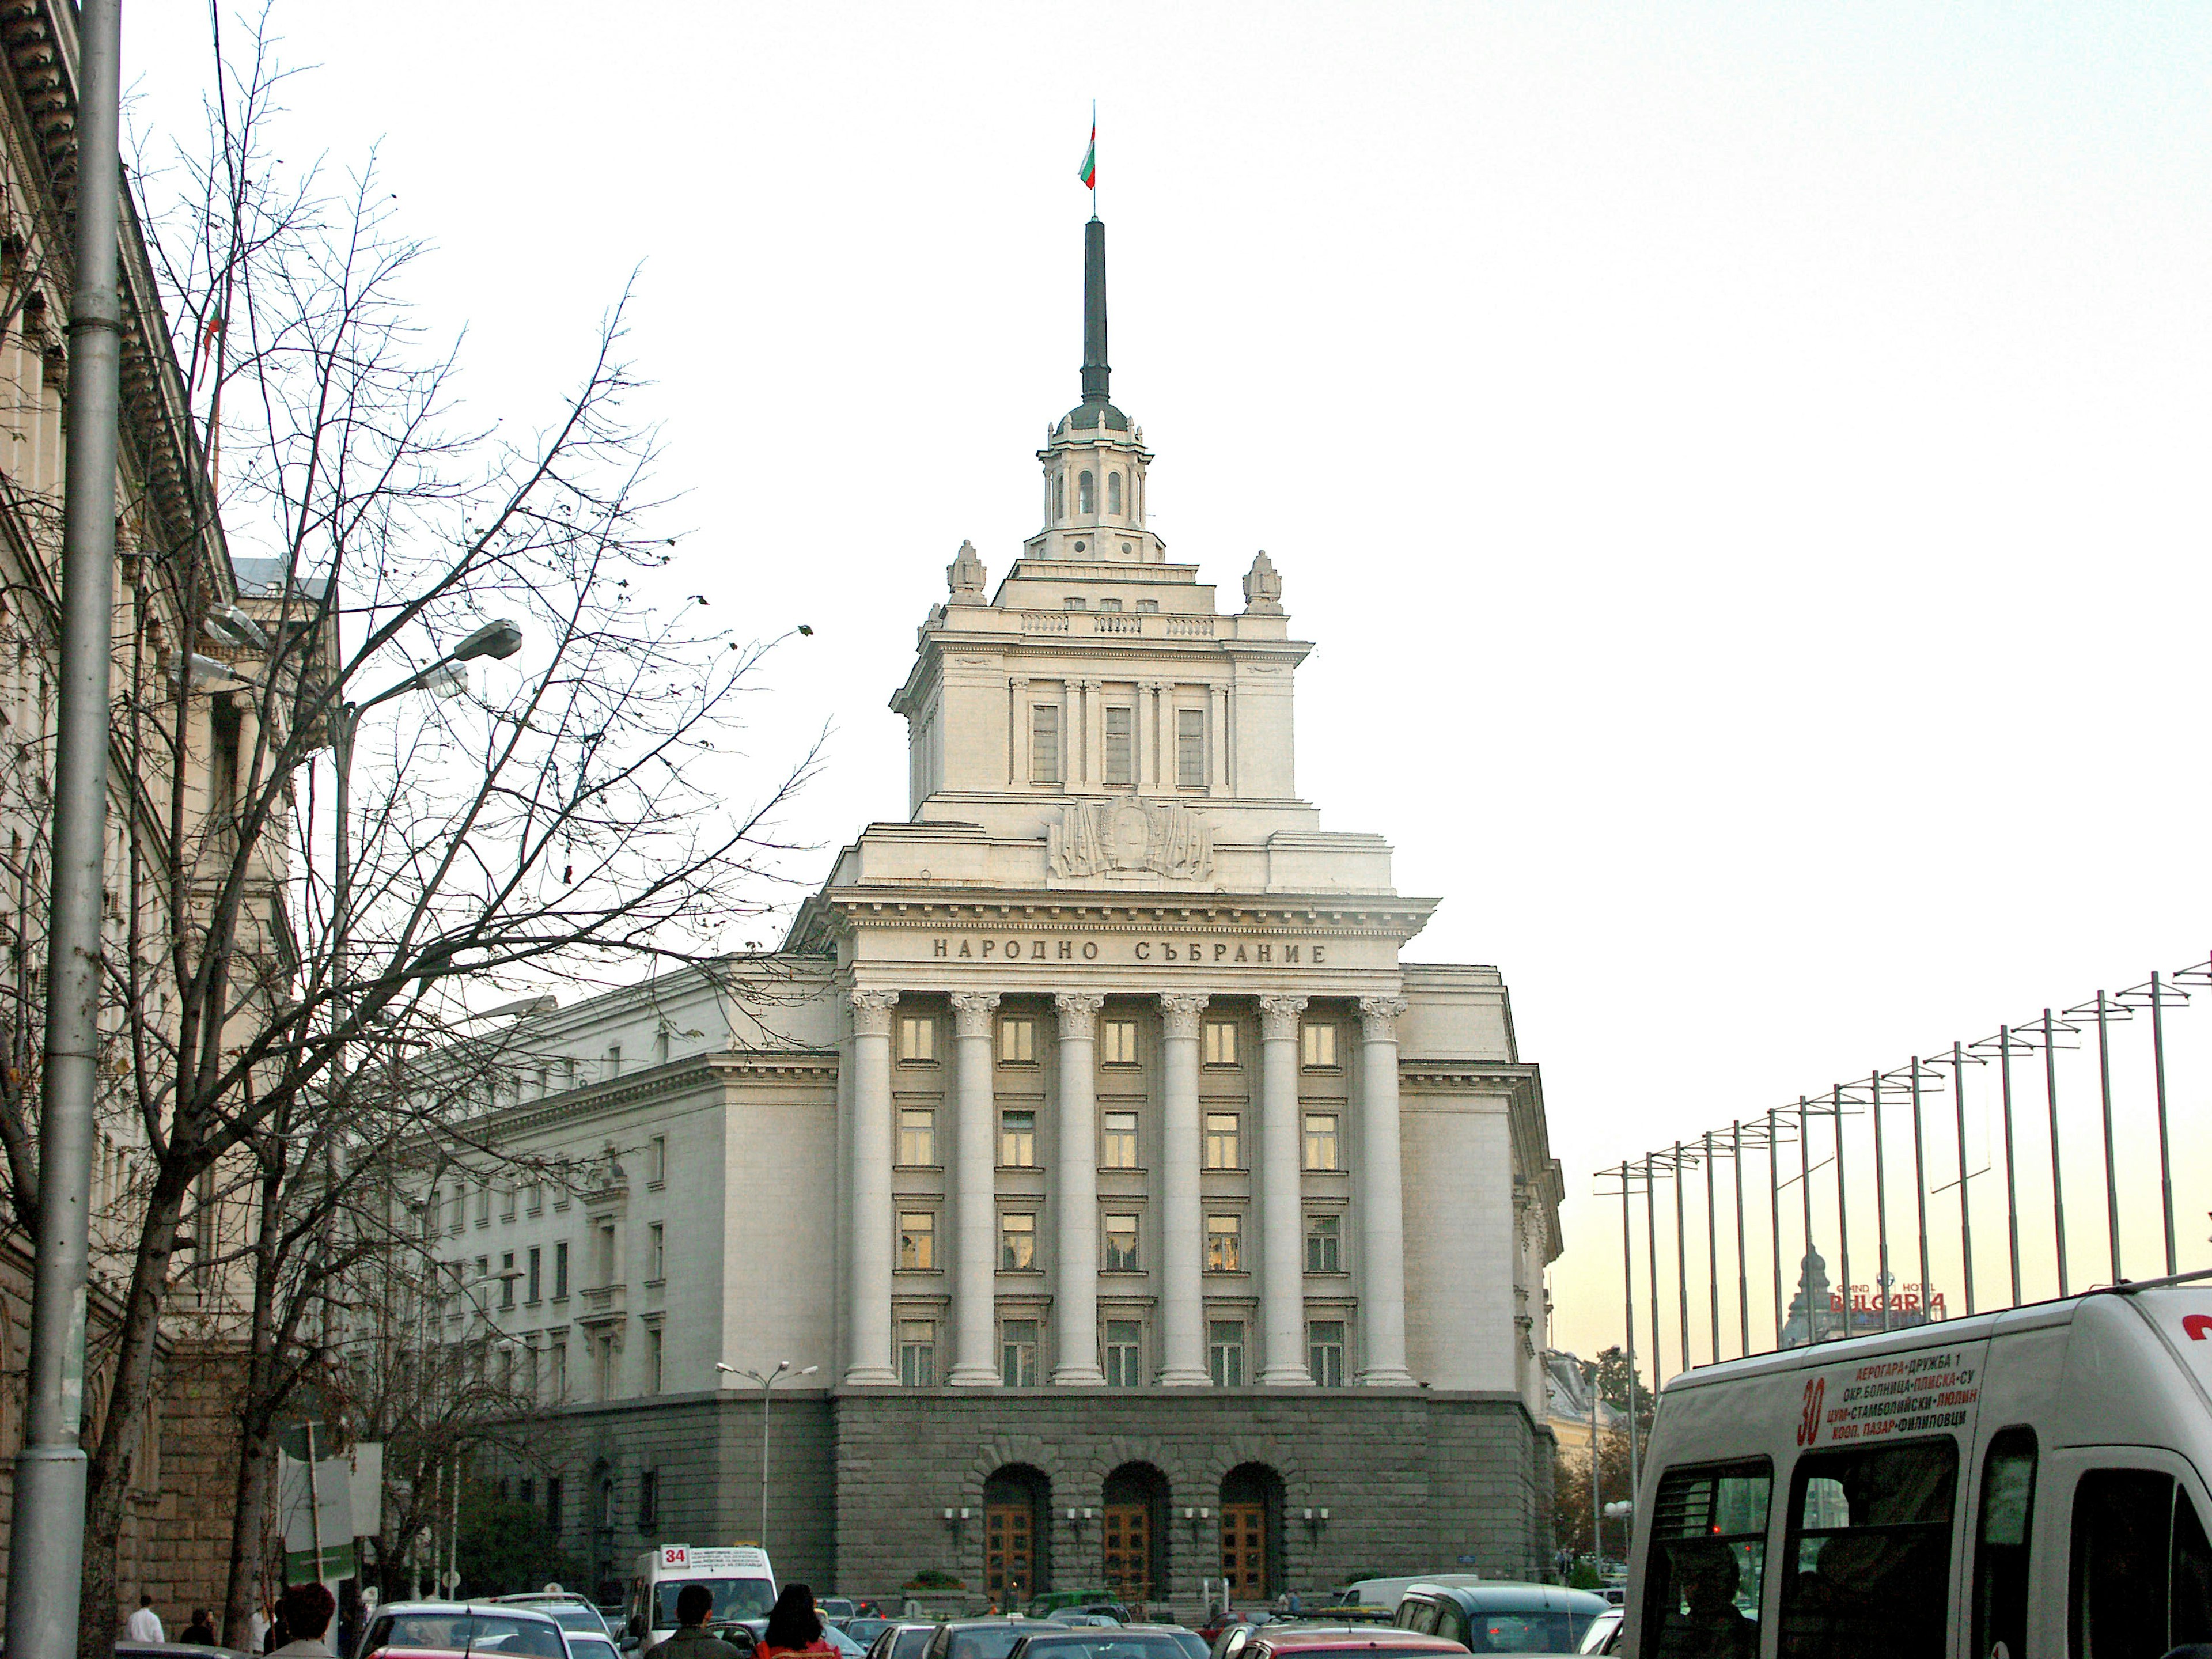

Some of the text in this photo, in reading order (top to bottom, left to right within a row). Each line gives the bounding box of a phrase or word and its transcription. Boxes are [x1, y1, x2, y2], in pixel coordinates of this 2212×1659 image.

[934, 938, 1325, 964] НАРОДНО СЪБРАНИЕ
[1903, 1283, 1936, 1291] HOL
[1830, 1293, 1944, 1312] BULGARA
[1797, 1377, 1825, 1446] 30
[665, 1549, 685, 1563] 34
